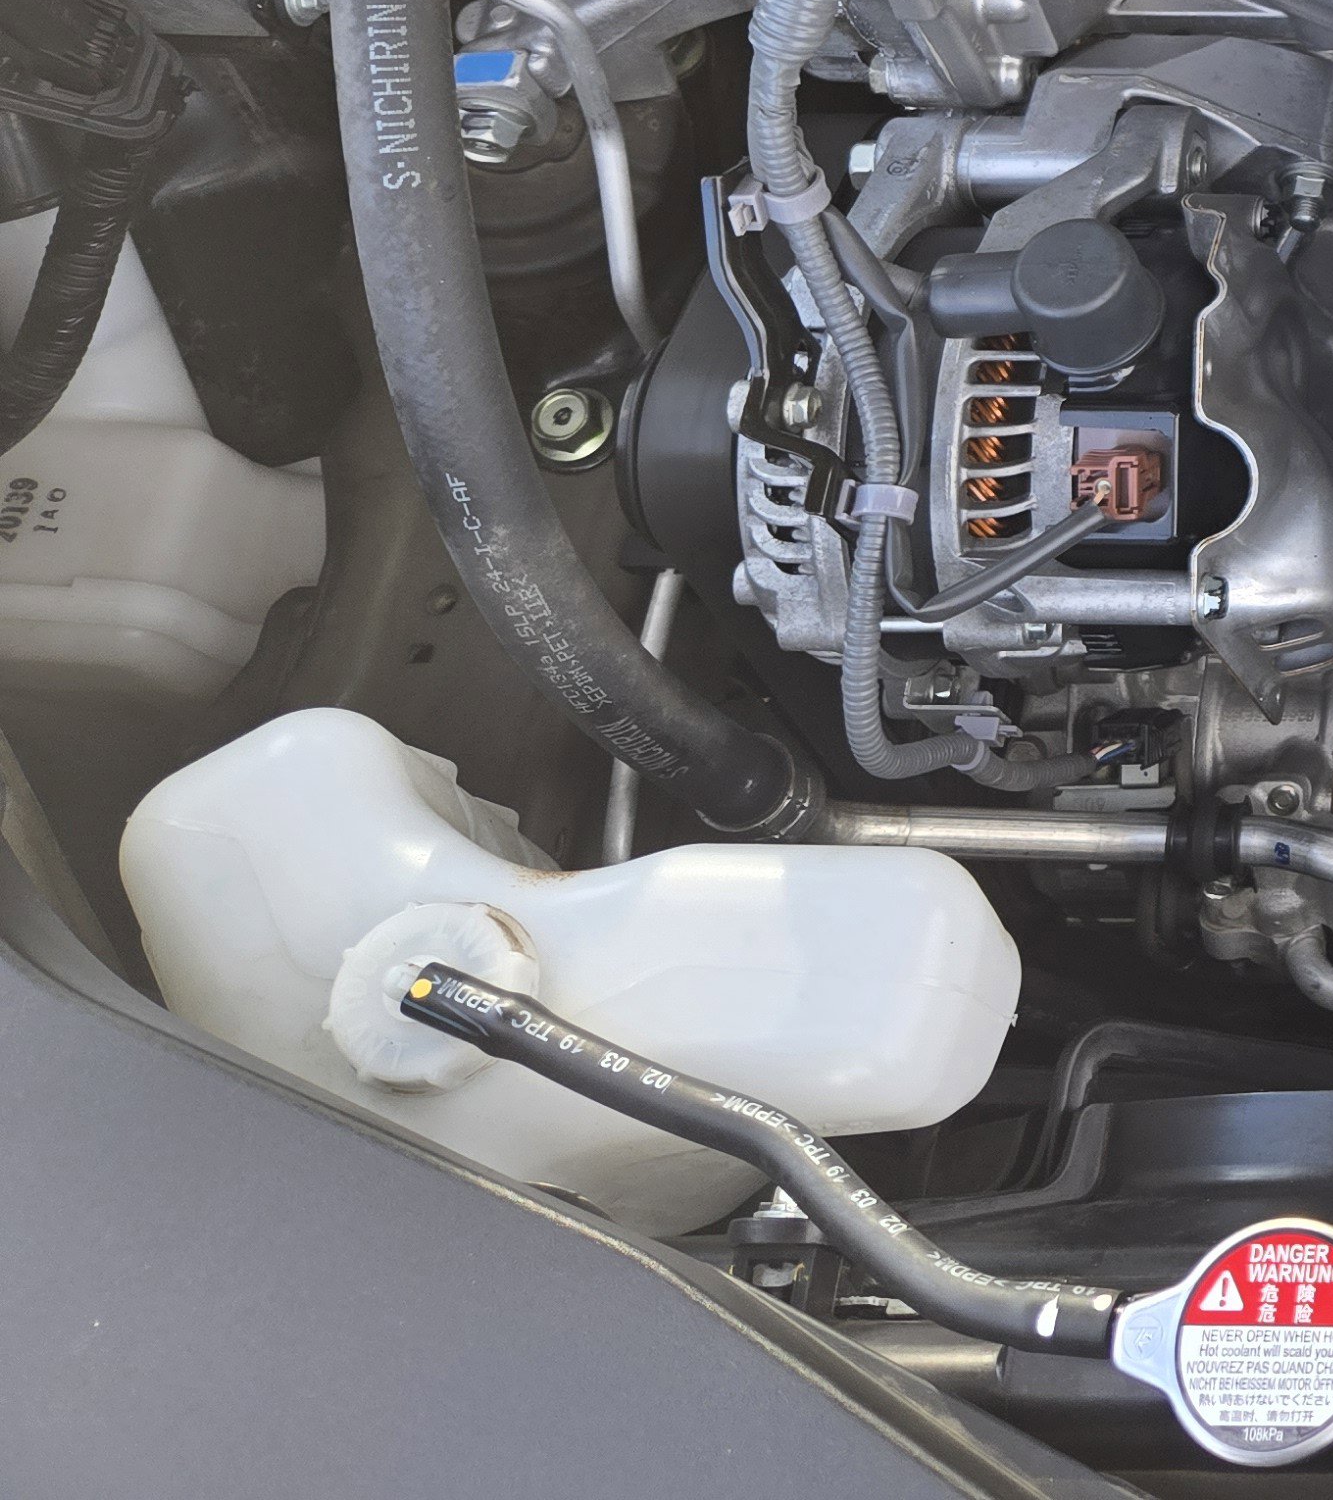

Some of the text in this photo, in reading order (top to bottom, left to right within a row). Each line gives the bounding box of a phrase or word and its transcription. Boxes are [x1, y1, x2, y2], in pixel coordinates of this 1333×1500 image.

[511, 1010, 556, 1042] TPC
[794, 1134, 831, 1165] TPC
[1249, 1243, 1330, 1263] DANGER
[1201, 1329, 1244, 1343] NEVER
[1246, 1329, 1280, 1343] OPEN
[1283, 1330, 1321, 1343] WHEN
[1199, 1344, 1219, 1358] Hot
[1221, 1344, 1261, 1358] coolant
[1263, 1345, 1281, 1358] will
[1283, 1345, 1312, 1359] scald
[1186, 1360, 1245, 1375] N'OUVREZ
[1246, 1361, 1270, 1375] PAS
[1272, 1361, 1314, 1376] QUAND
[1189, 1377, 1217, 1391] NICHT
[1218, 1377, 1234, 1391] BEI
[1235, 1377, 1276, 1391] HEISSEM
[1277, 1377, 1312, 1391] MOTOR
[1243, 1427, 1284, 1442] 108kPa
